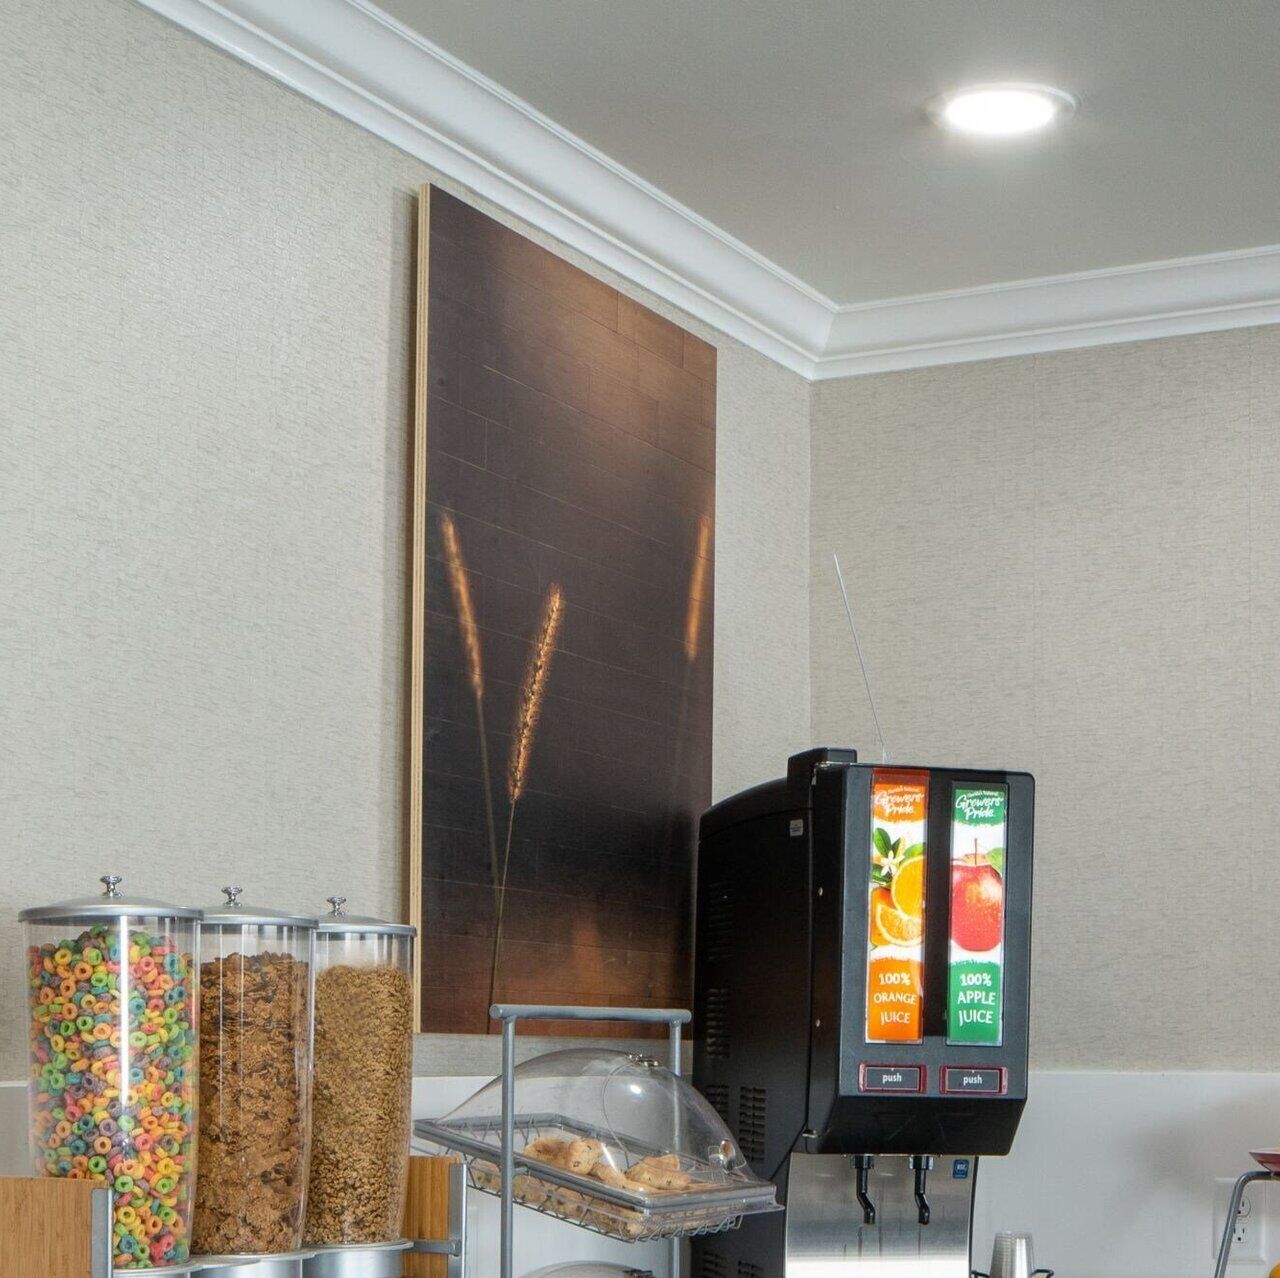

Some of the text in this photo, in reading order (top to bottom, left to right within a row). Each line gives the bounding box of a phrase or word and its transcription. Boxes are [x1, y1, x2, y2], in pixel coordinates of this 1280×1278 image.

[956, 794, 1004, 809] Growers
[885, 802, 914, 816] Pride
[964, 807, 994, 820] Pride
[879, 973, 911, 986] 100%
[960, 973, 992, 987] 100%
[874, 992, 918, 1005] ORANGE
[957, 991, 996, 1005] APPLE
[881, 1011, 911, 1025] JUICE
[959, 1010, 993, 1026] JUICE
[882, 1073, 902, 1084] push
[963, 1075, 983, 1086] push
